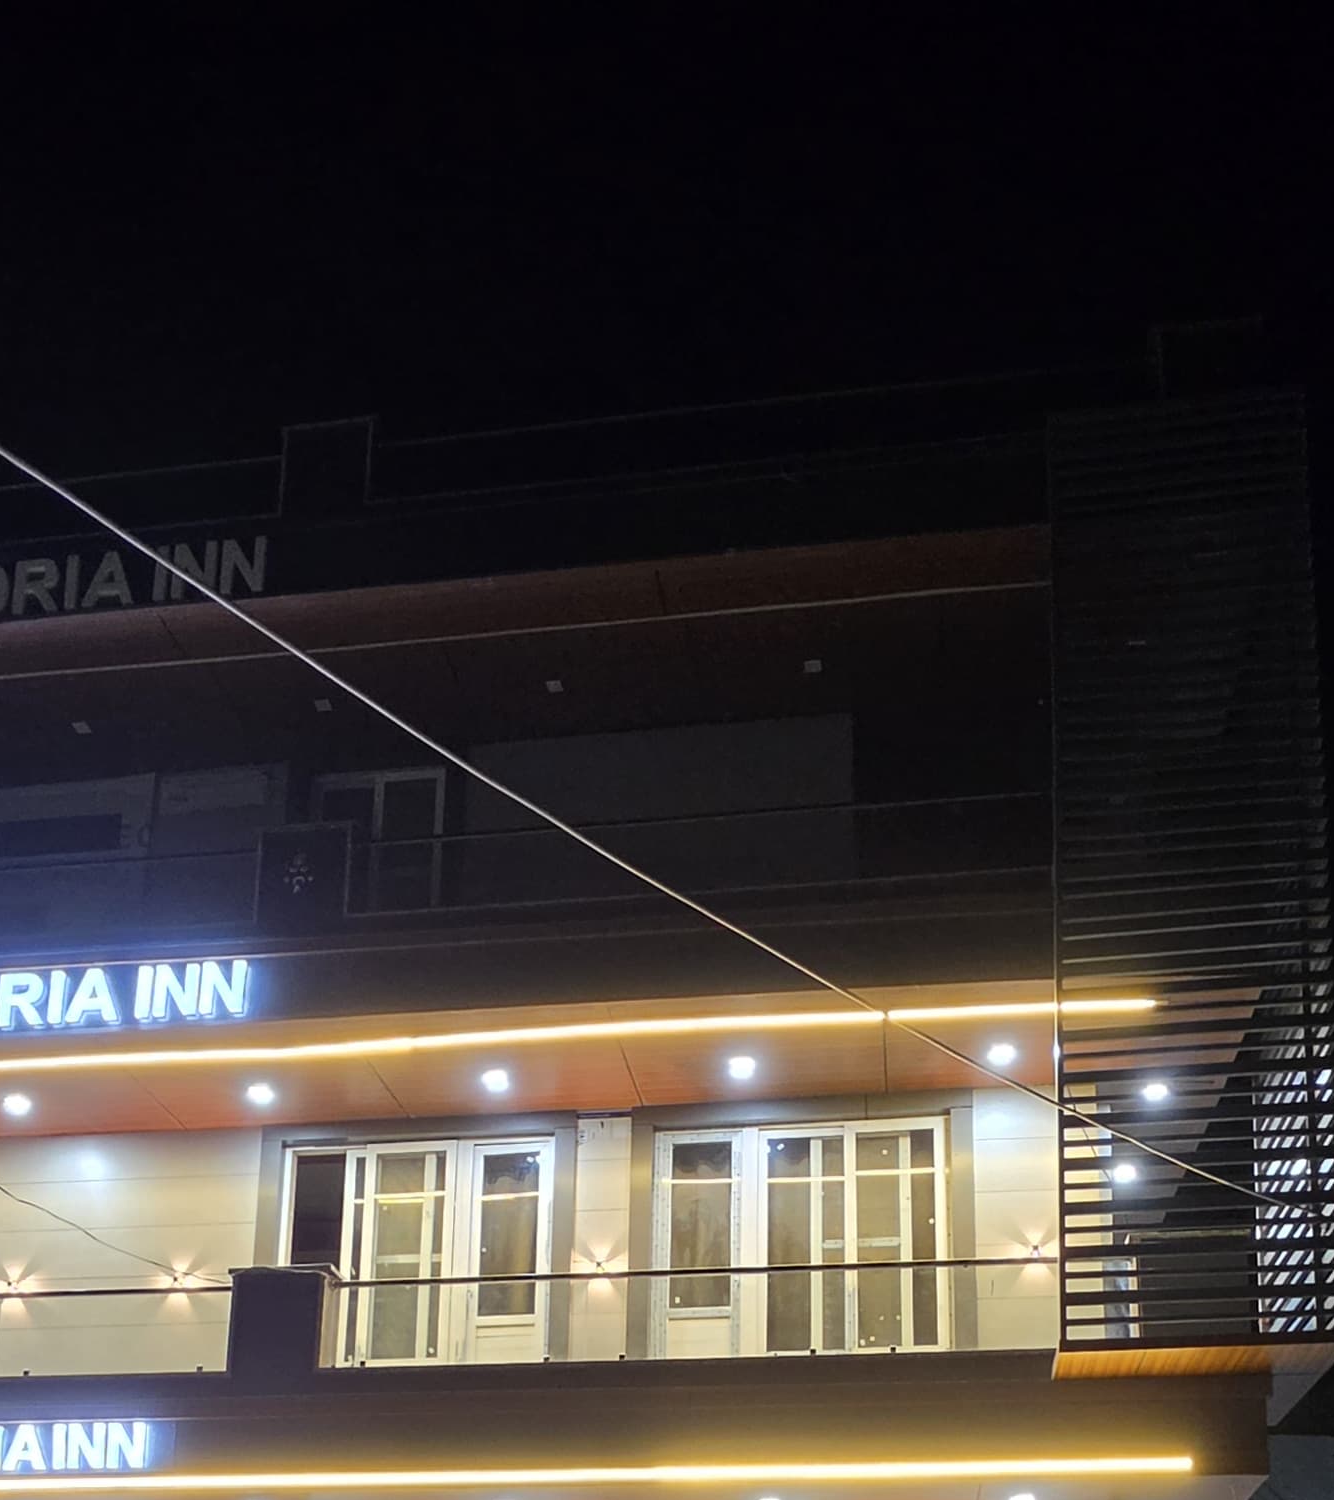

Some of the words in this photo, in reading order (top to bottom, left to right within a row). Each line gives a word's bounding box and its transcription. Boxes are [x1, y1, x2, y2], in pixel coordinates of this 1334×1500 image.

[152, 535, 268, 601] INN
[132, 959, 252, 1021] INN
[51, 1420, 149, 1470] INN
